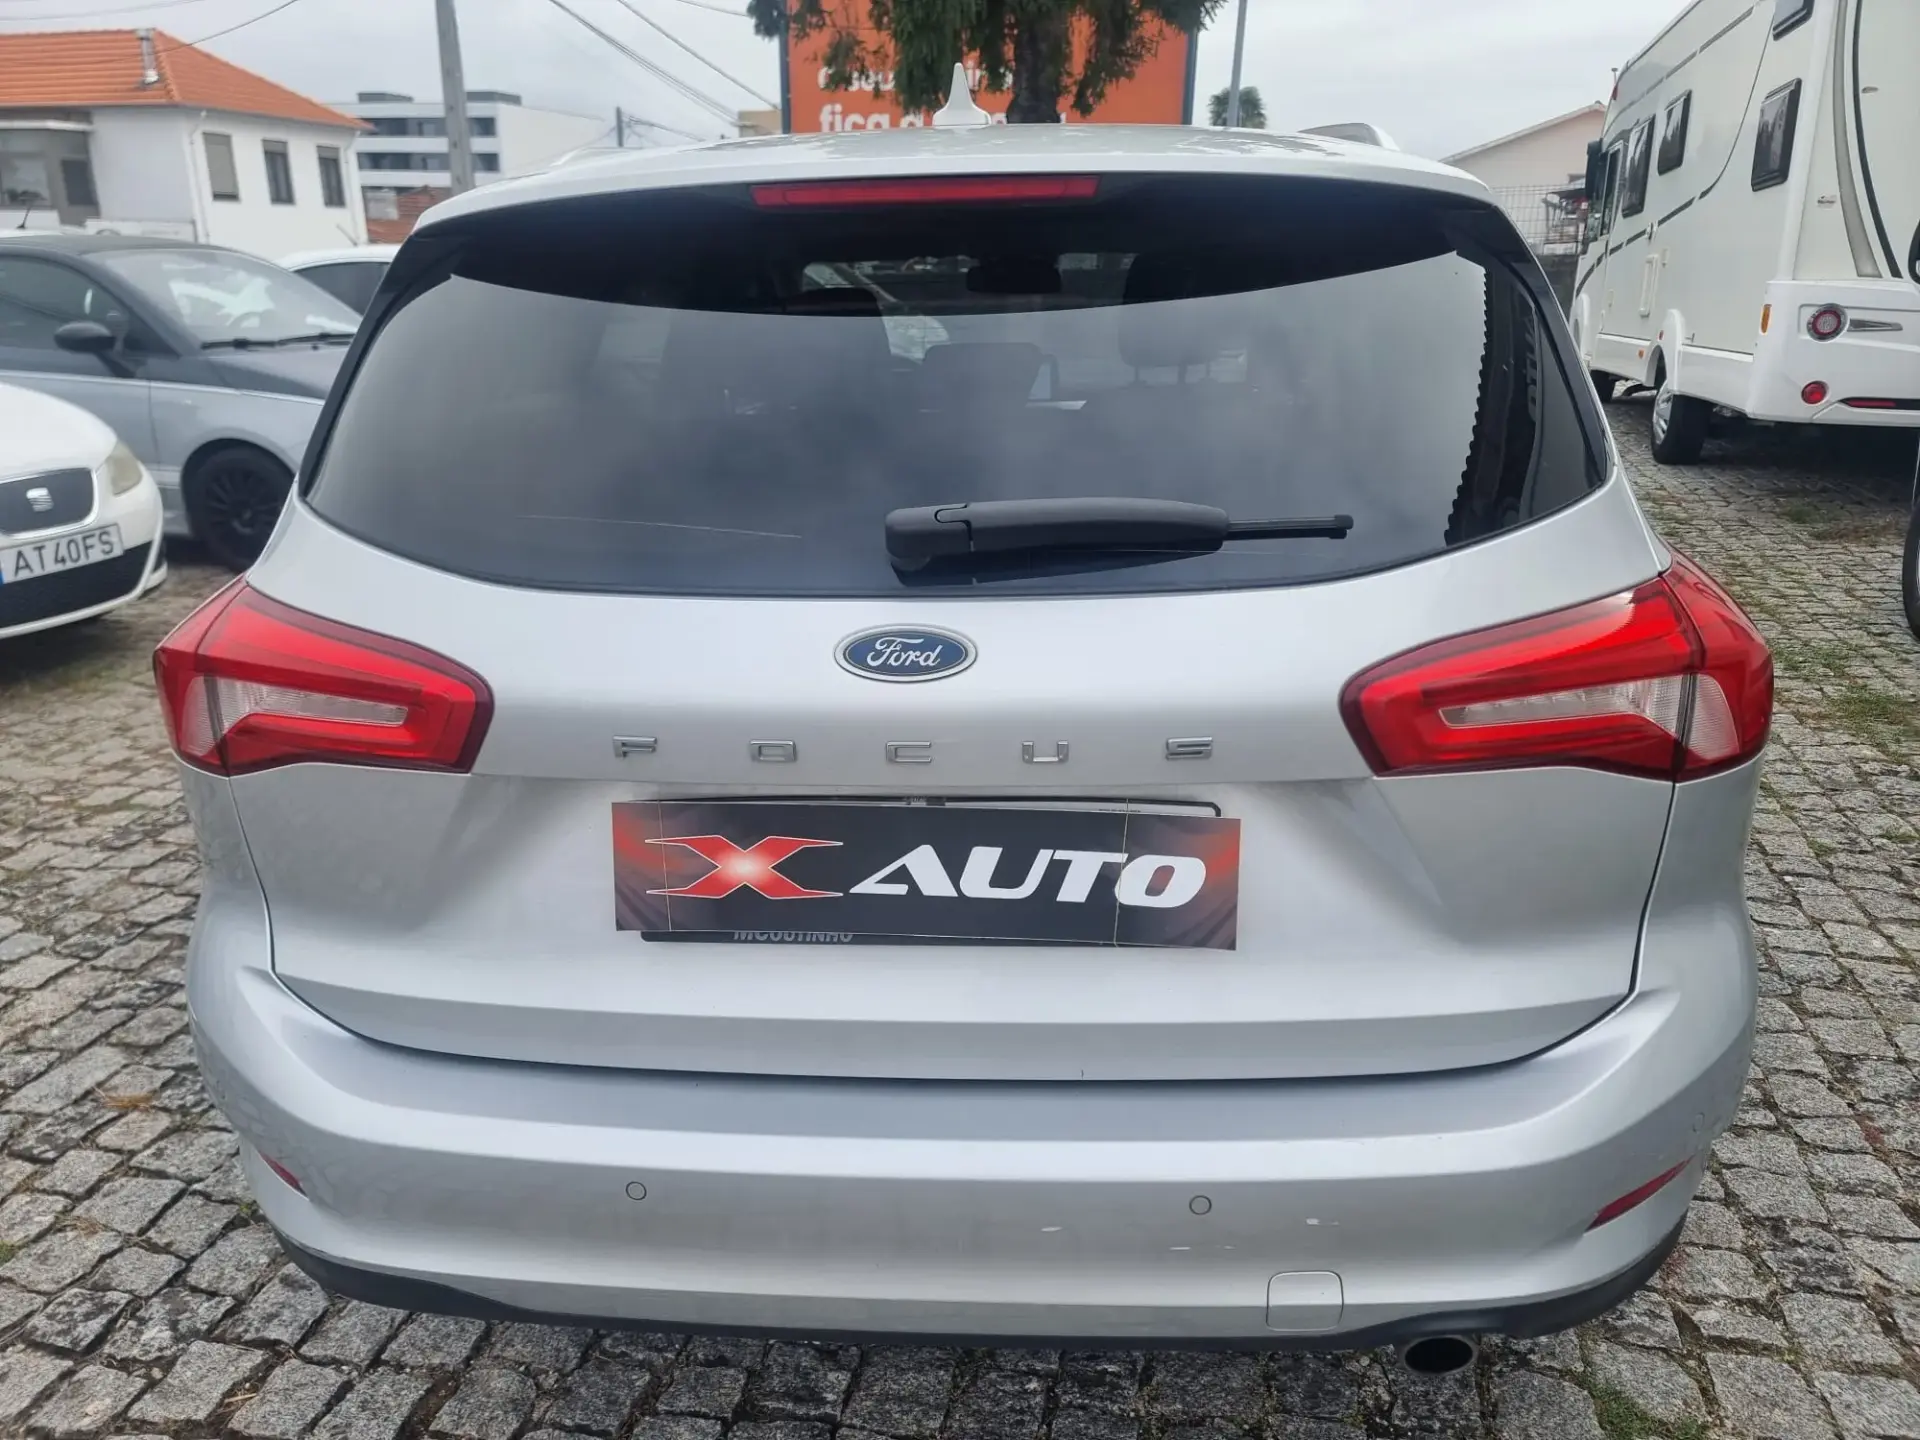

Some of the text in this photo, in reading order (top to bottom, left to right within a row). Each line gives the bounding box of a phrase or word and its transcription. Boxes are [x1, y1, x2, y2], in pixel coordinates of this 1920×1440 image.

[866, 636, 944, 667] Ford
[613, 735, 1213, 762] FOCUS
[849, 844, 1206, 908] AUTO
